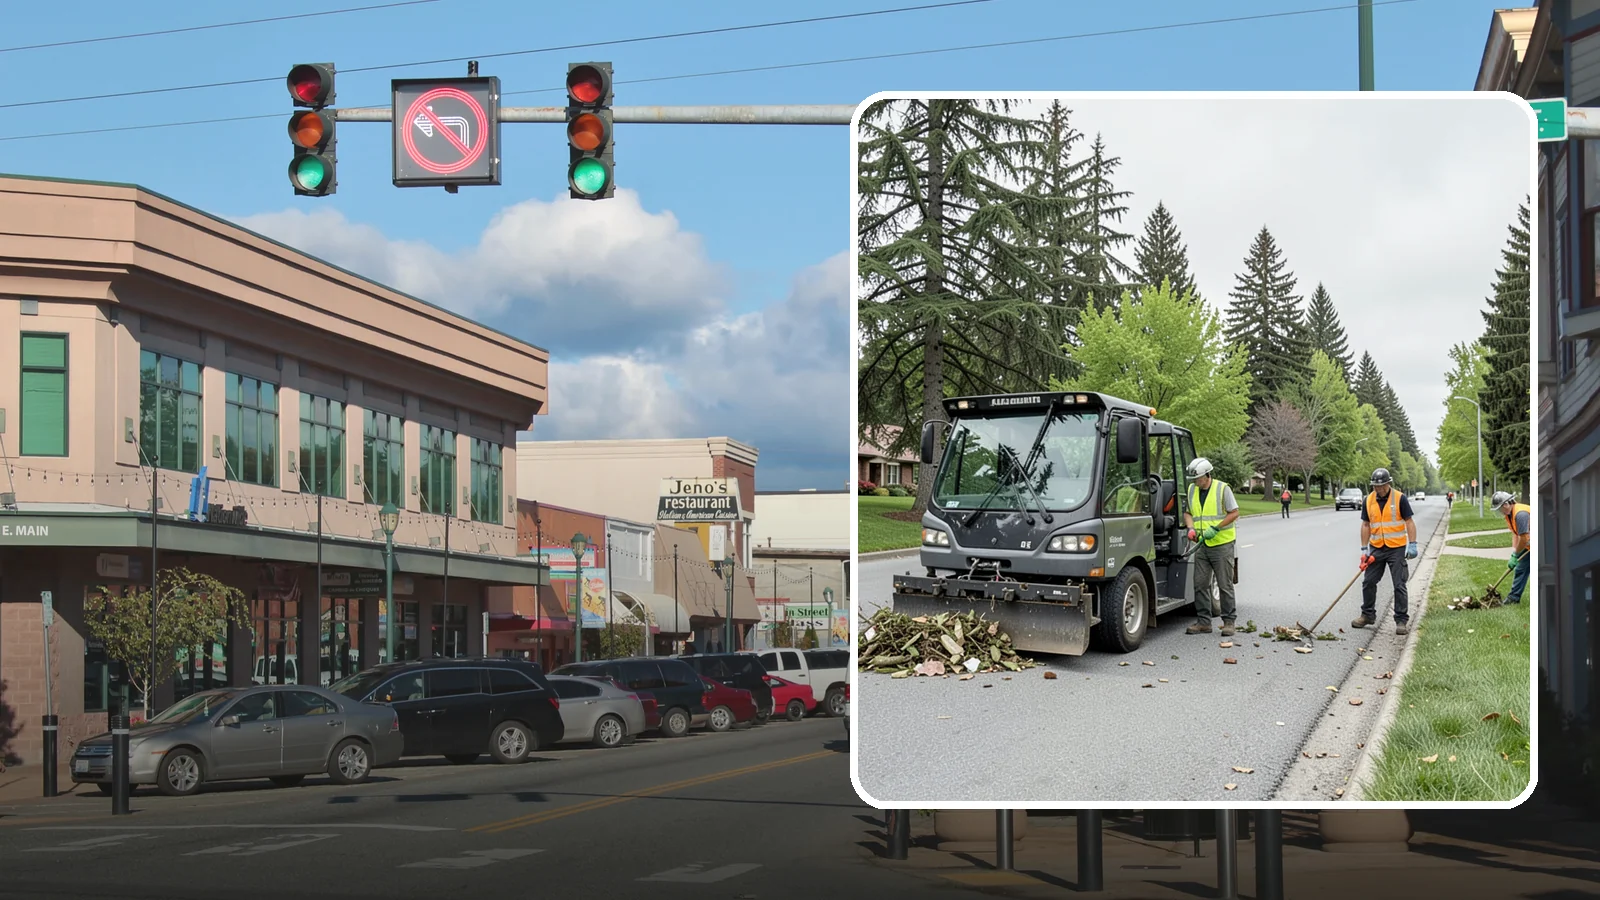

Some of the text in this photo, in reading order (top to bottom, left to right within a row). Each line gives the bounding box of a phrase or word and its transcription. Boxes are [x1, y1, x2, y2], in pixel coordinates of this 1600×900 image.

[670, 480, 727, 494] Jeno's
[665, 496, 731, 509] restaurant
[658, 510, 681, 520] Italian
[686, 510, 714, 519] American
[715, 510, 737, 519] Cuisine
[2, 525, 49, 536] E. MAIN
[797, 607, 828, 617] Street
